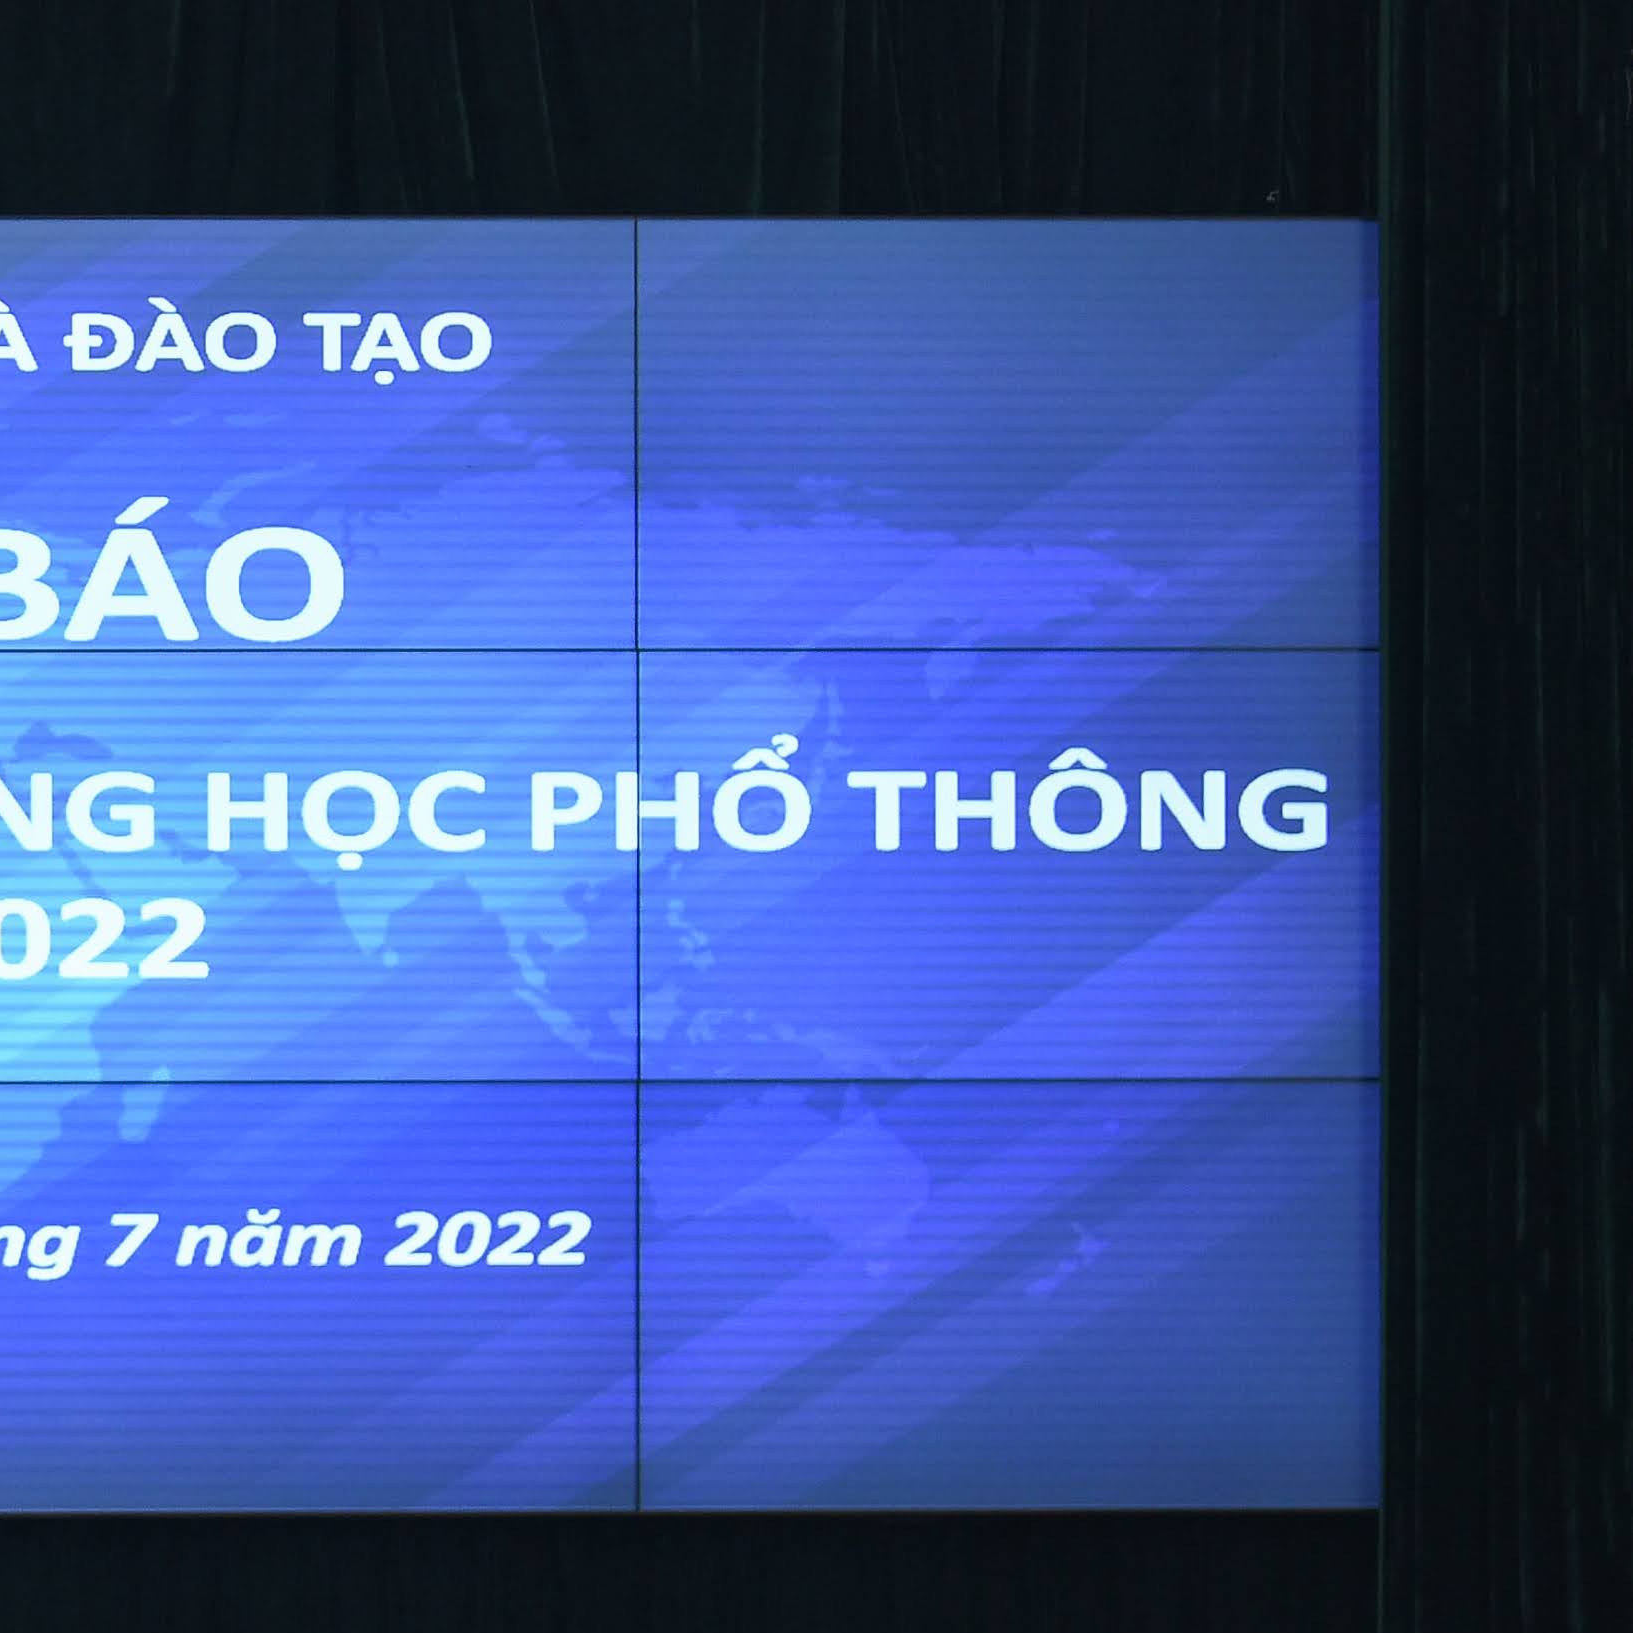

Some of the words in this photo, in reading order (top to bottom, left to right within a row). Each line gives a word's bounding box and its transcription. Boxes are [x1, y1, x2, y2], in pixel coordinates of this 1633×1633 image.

[63, 297, 277, 372] ĐÀO
[303, 312, 492, 385] TẠO
[207, 770, 486, 870] HỌC
[531, 734, 811, 851] PHỔ
[847, 748, 1327, 851] THÔNG
[106, 1213, 159, 1267] 7
[176, 1208, 362, 1267] năm
[384, 1211, 591, 1266] 2022
